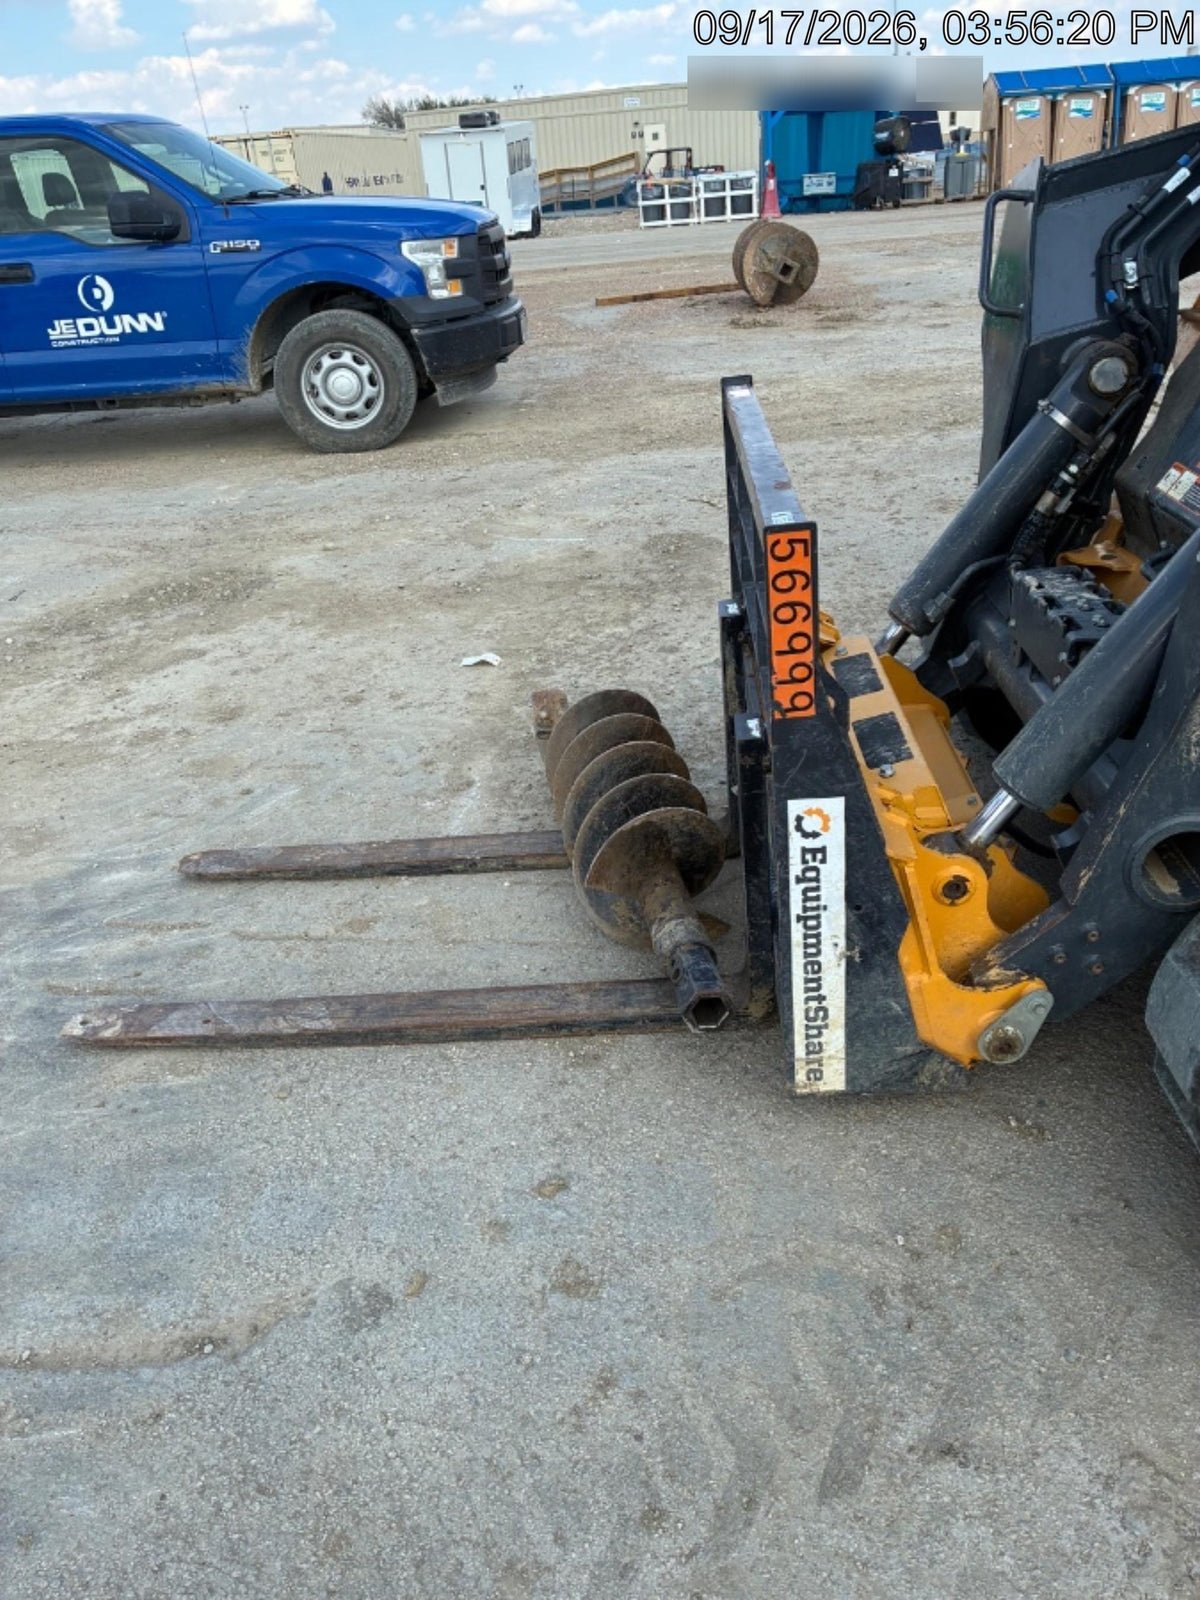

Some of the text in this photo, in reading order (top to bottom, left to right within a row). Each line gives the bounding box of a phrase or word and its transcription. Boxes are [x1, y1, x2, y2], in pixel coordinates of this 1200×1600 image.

[50, 336, 120, 348] CONSTRUCTION
[769, 537, 814, 712] 566999
[794, 845, 829, 1083] EquipmentShare
